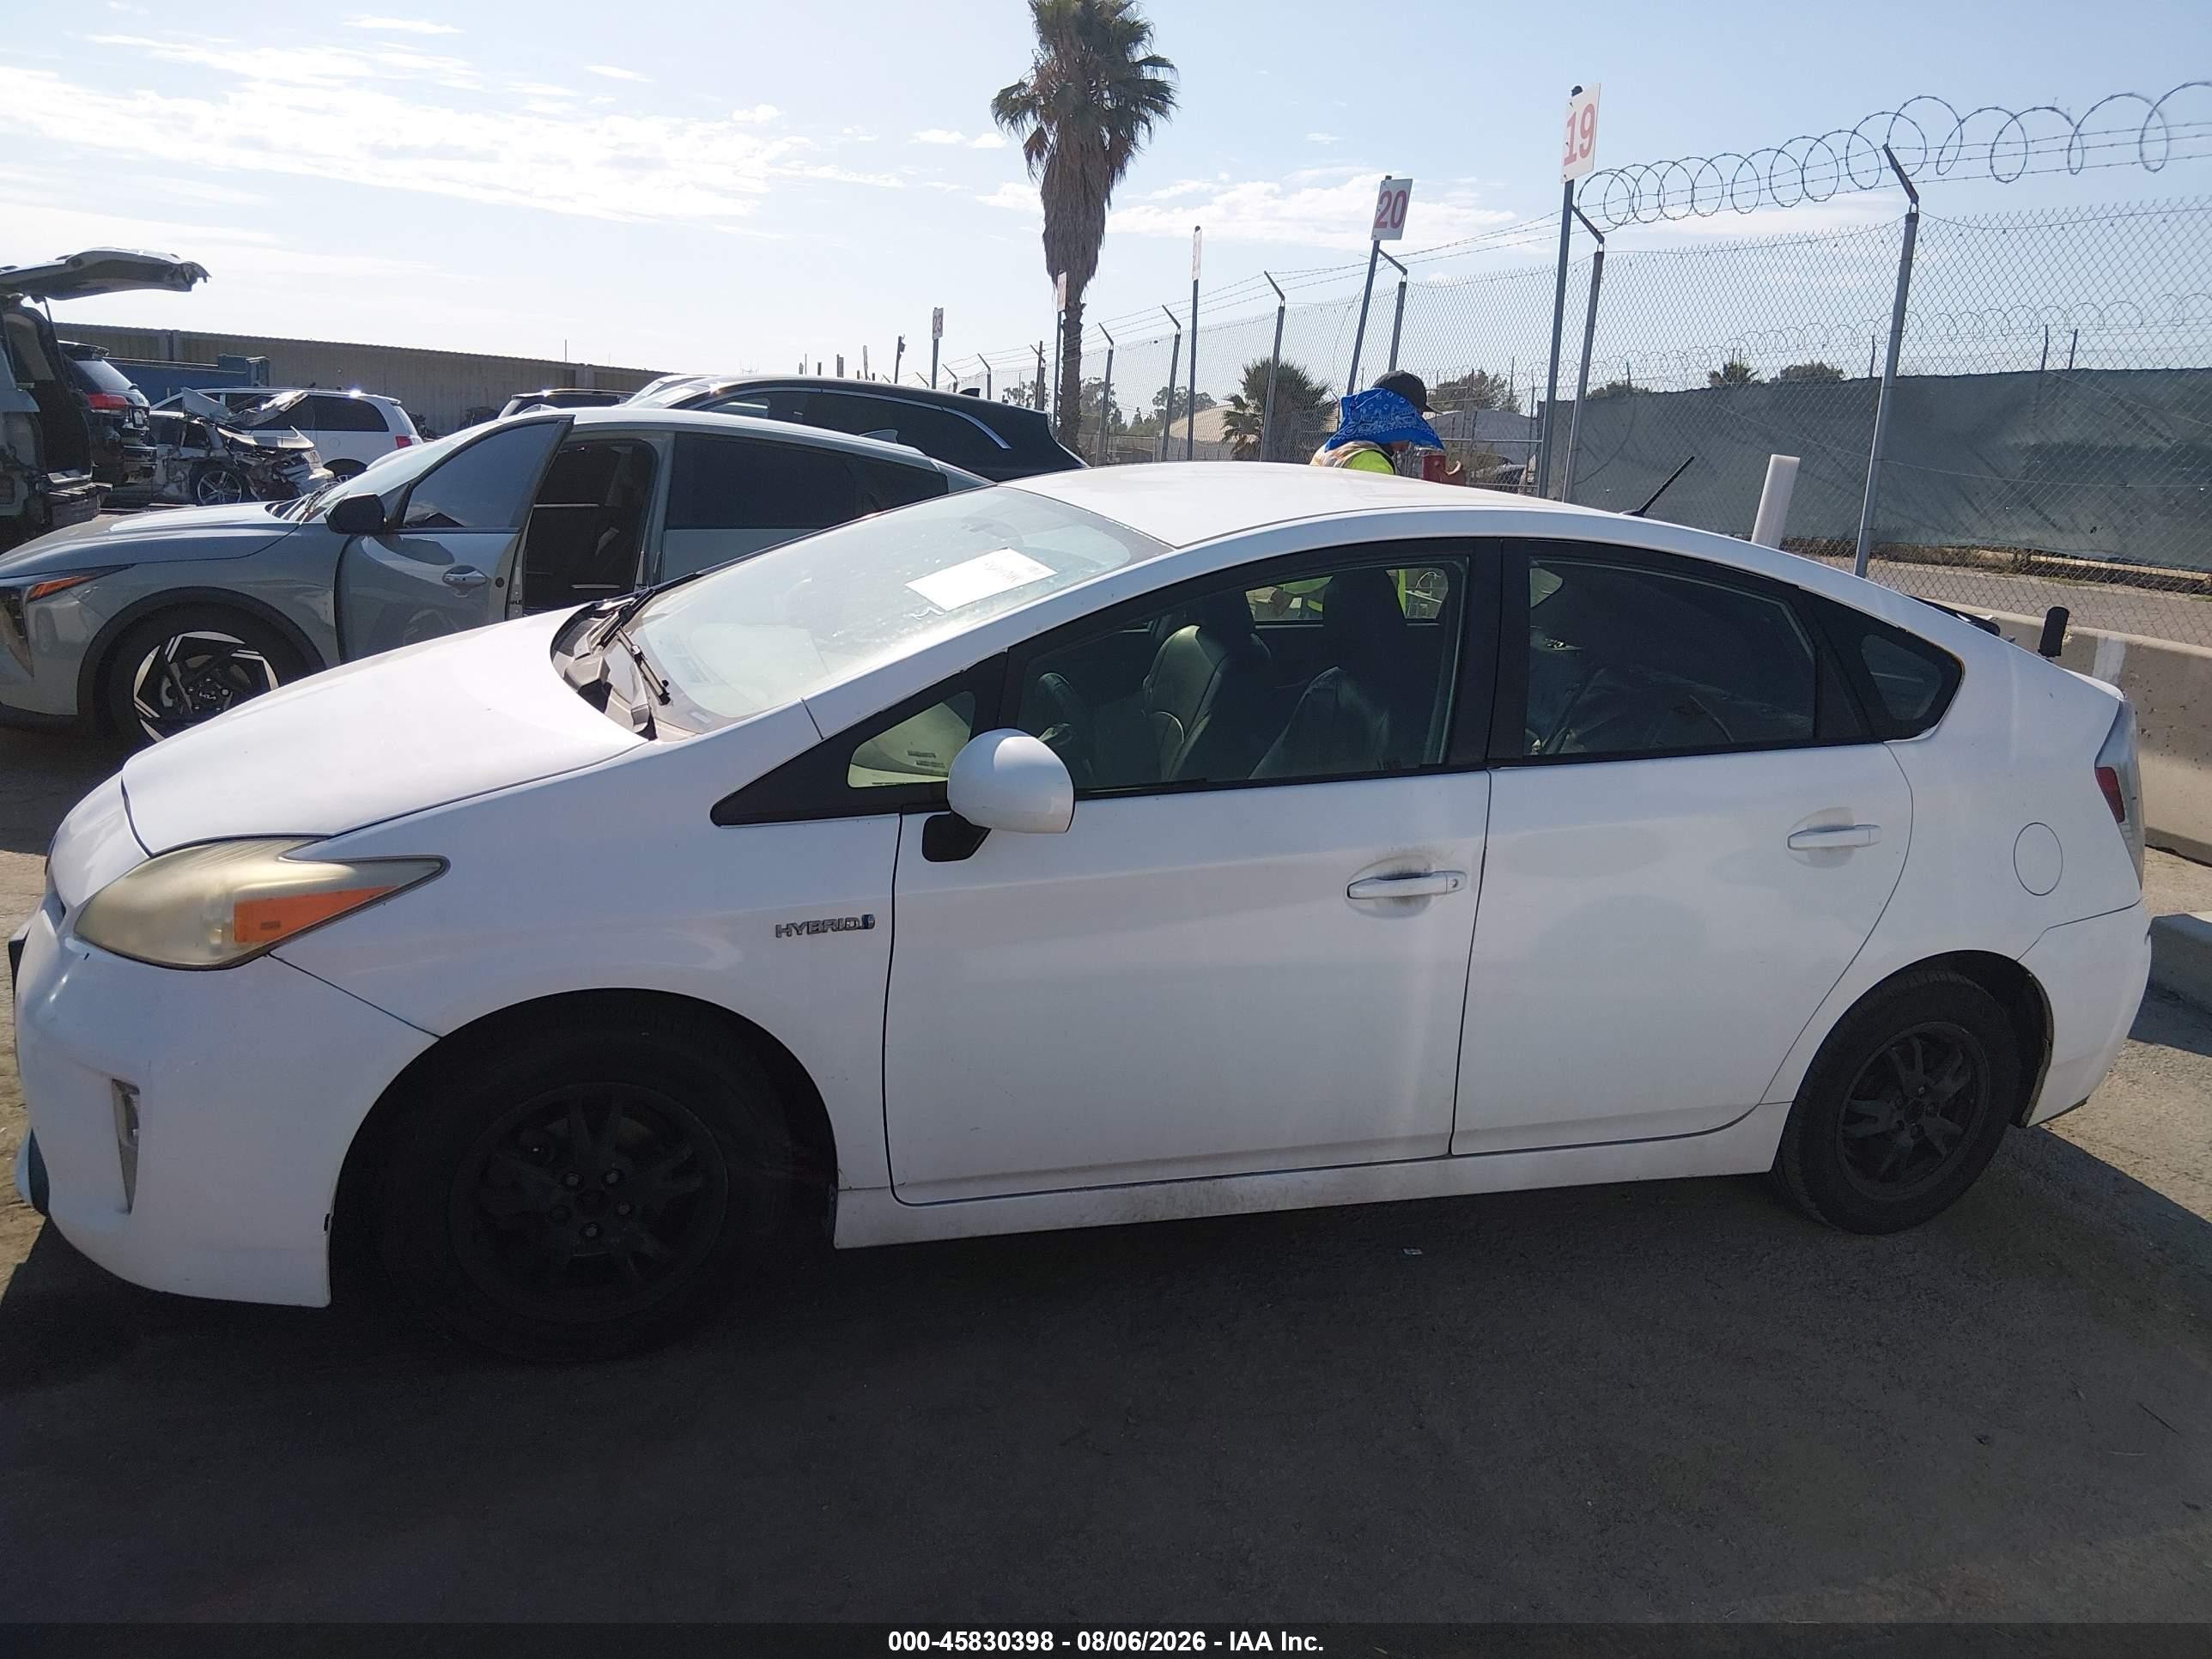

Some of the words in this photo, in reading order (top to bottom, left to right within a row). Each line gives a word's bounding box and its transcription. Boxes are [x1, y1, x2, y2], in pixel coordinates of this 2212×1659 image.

[1564, 103, 1595, 167] 19
[1374, 190, 1407, 229] 20
[933, 313, 943, 334] 23
[775, 916, 860, 938] HYBRID
